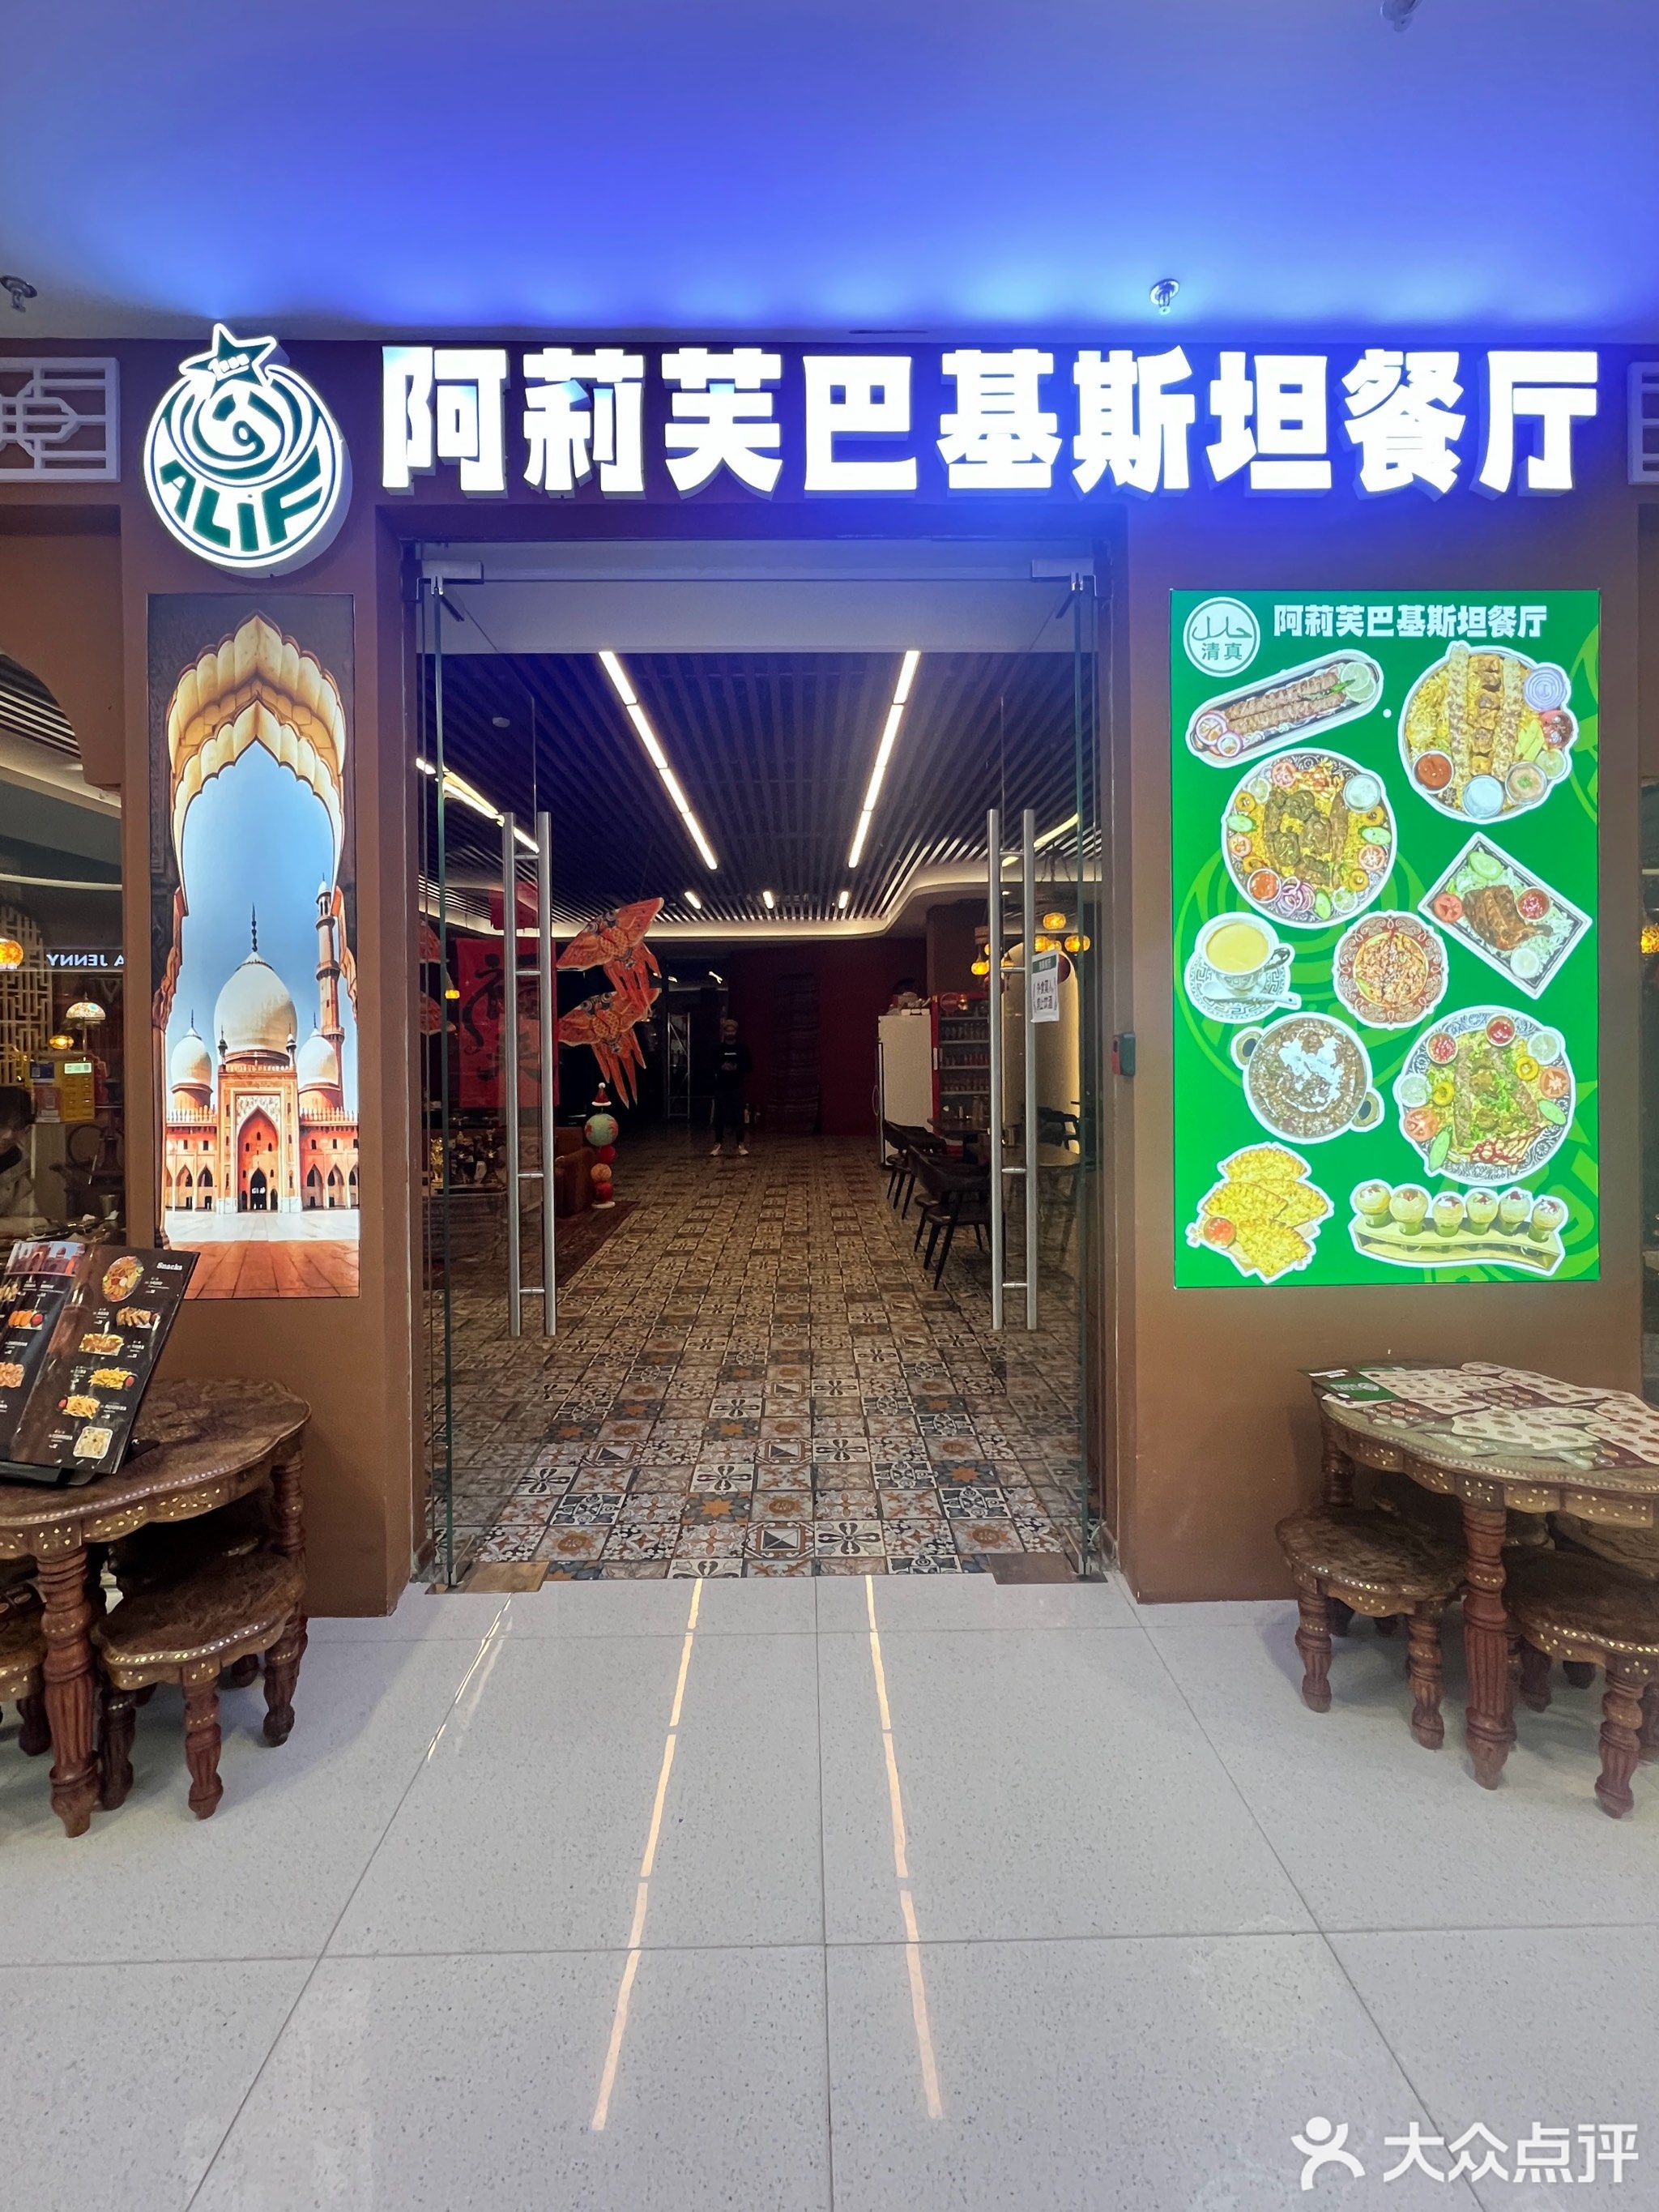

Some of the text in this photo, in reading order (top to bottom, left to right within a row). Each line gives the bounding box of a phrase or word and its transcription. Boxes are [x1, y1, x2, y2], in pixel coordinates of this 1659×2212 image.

[382, 345, 1597, 493] 阿莉芙巴基斯坦餐厅
[1273, 604, 1547, 638] 阿莉芙巴基斯坦餐厅
[1201, 642, 1243, 661] 清真
